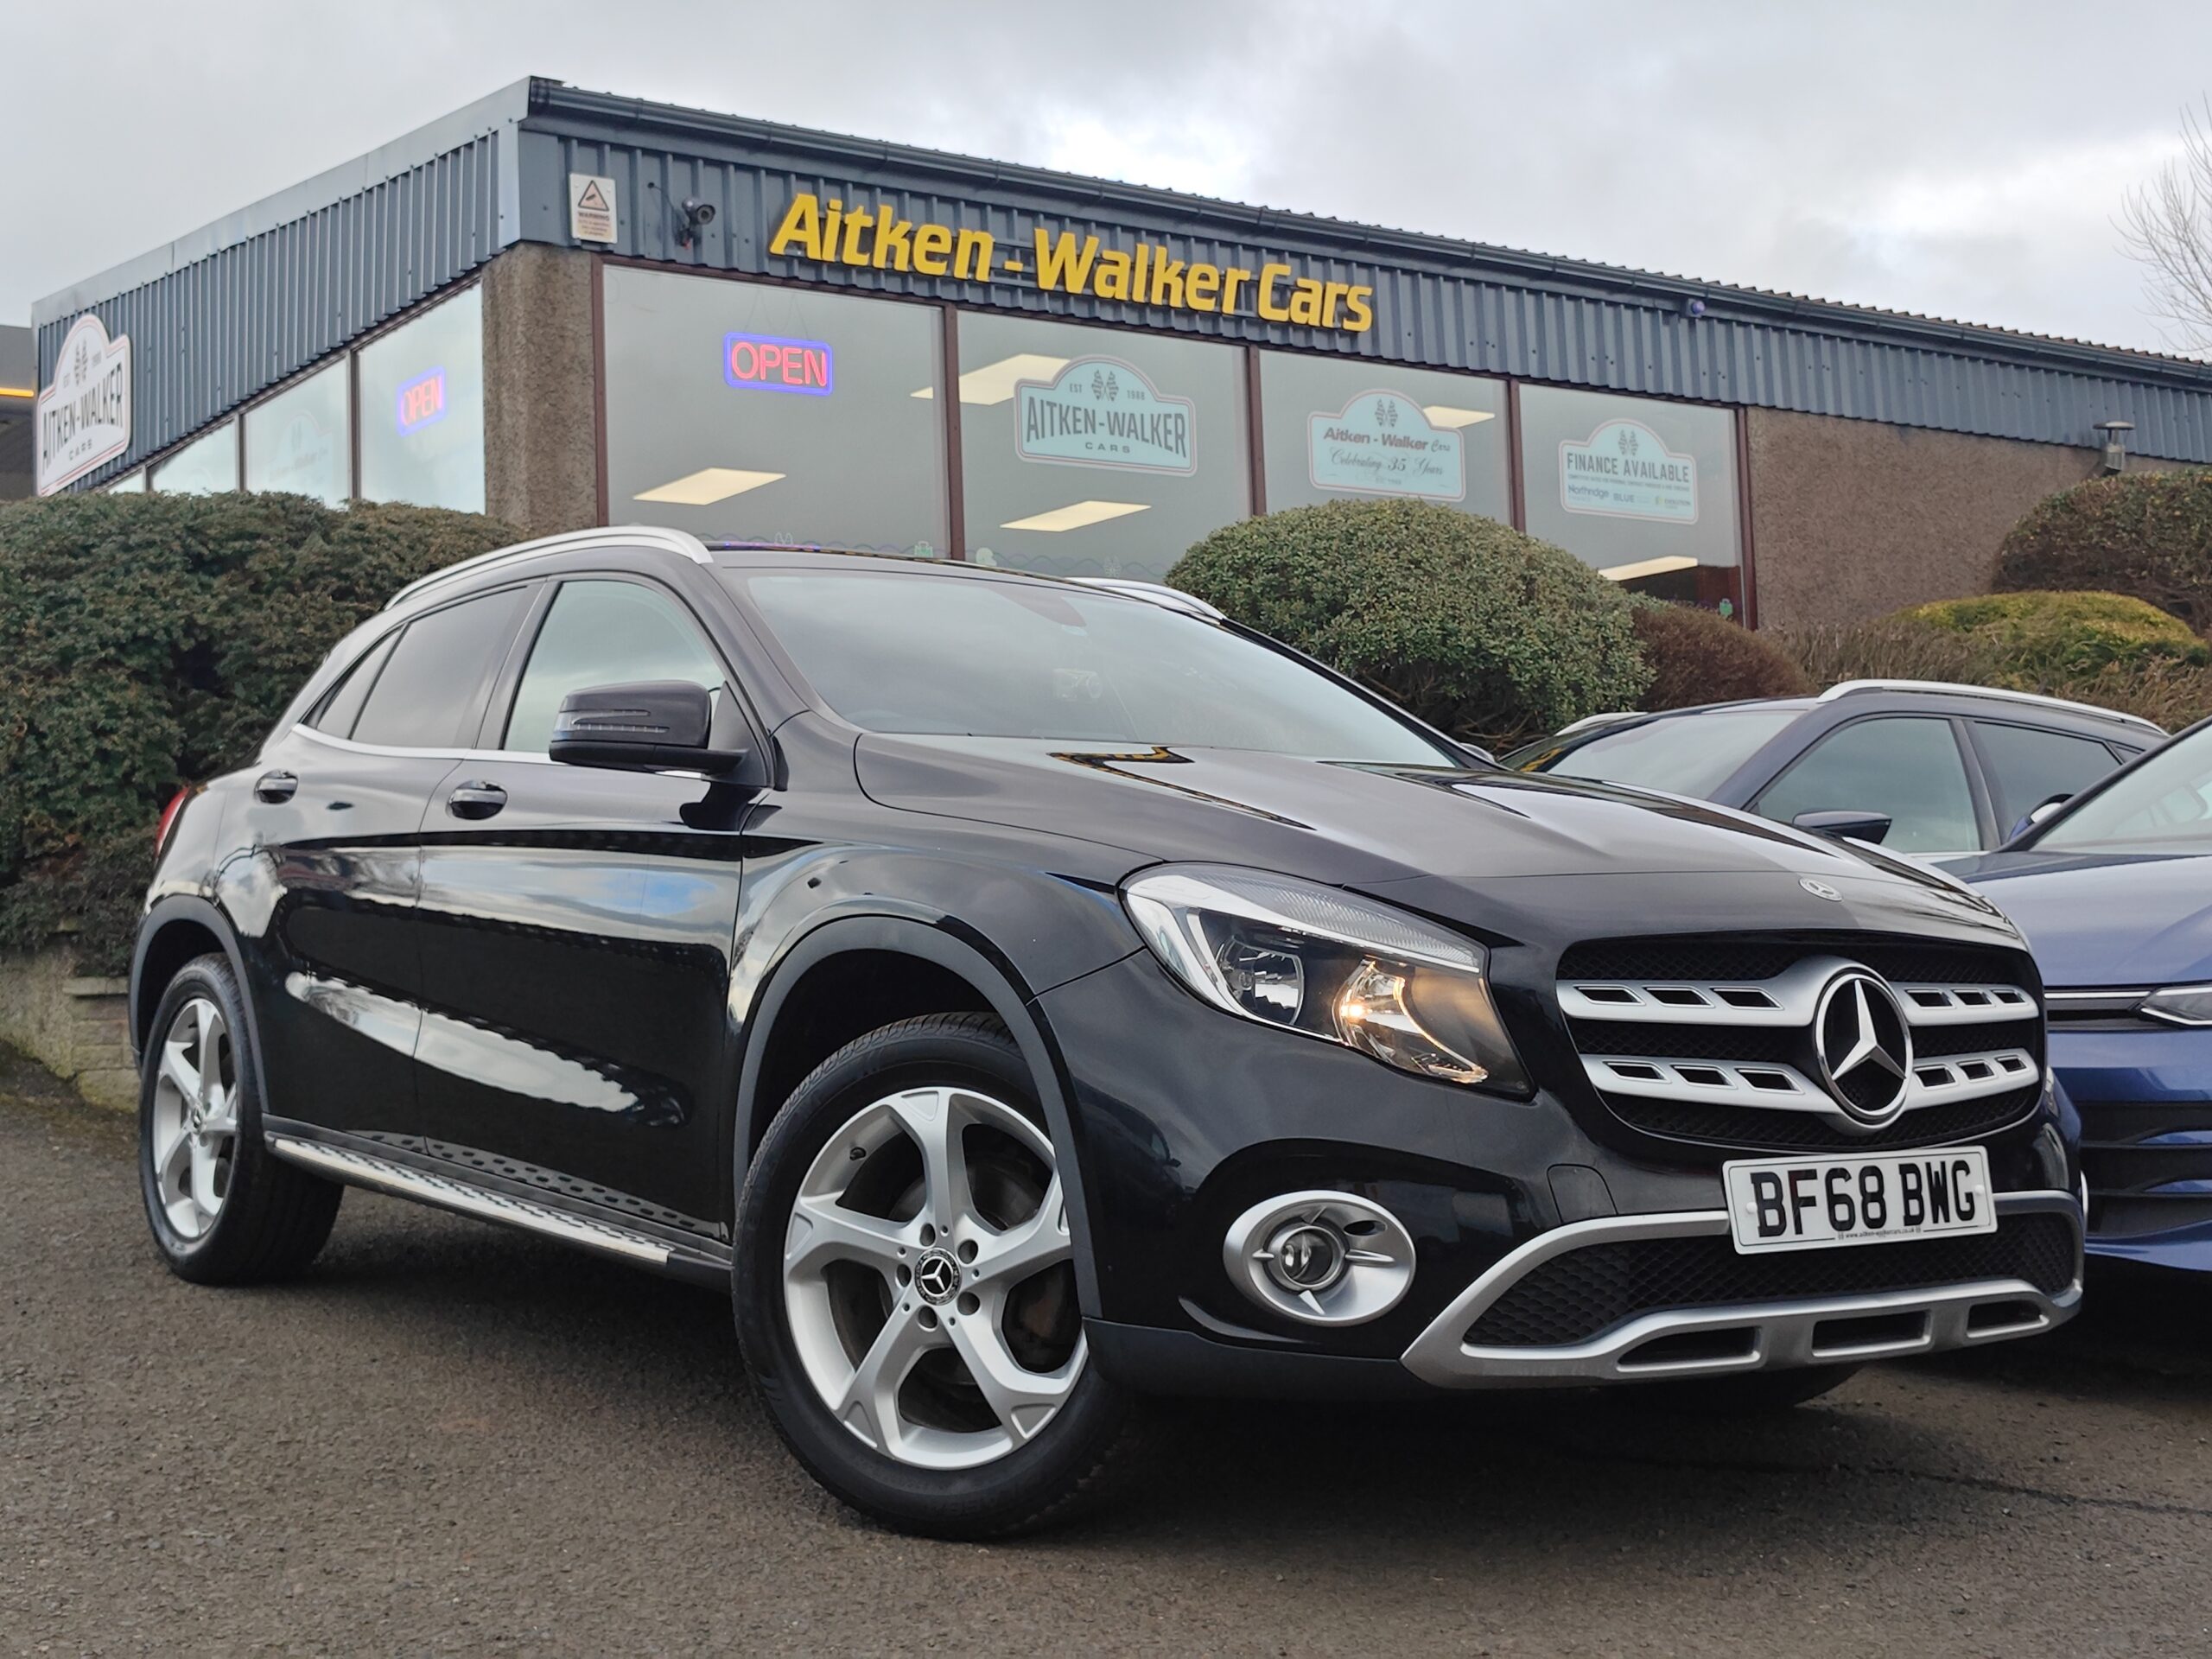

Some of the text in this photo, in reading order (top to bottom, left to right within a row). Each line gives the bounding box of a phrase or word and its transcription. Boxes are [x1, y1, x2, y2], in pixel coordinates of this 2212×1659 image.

[769, 193, 995, 283] Aitken
[1035, 228, 1251, 315] Walker
[1257, 261, 1374, 333] Cars
[732, 341, 827, 387] OPEN
[400, 374, 443, 427] OPEN
[1069, 383, 1083, 394] EST
[42, 361, 124, 477] AITKEN-WALKER
[1026, 396, 1186, 459] AITKEN-WALKER
[1085, 442, 1131, 454] CARS
[1324, 428, 1370, 444] Aitken
[1382, 433, 1428, 450] Walker
[1329, 446, 1443, 477] Celebrating 35 Years
[1567, 452, 1690, 483] FINANCE AVAILABLE
[1567, 484, 1610, 499] Northridge
[1612, 493, 1636, 504] BLUE
[1750, 1160, 1975, 1237] BF68 BWG
